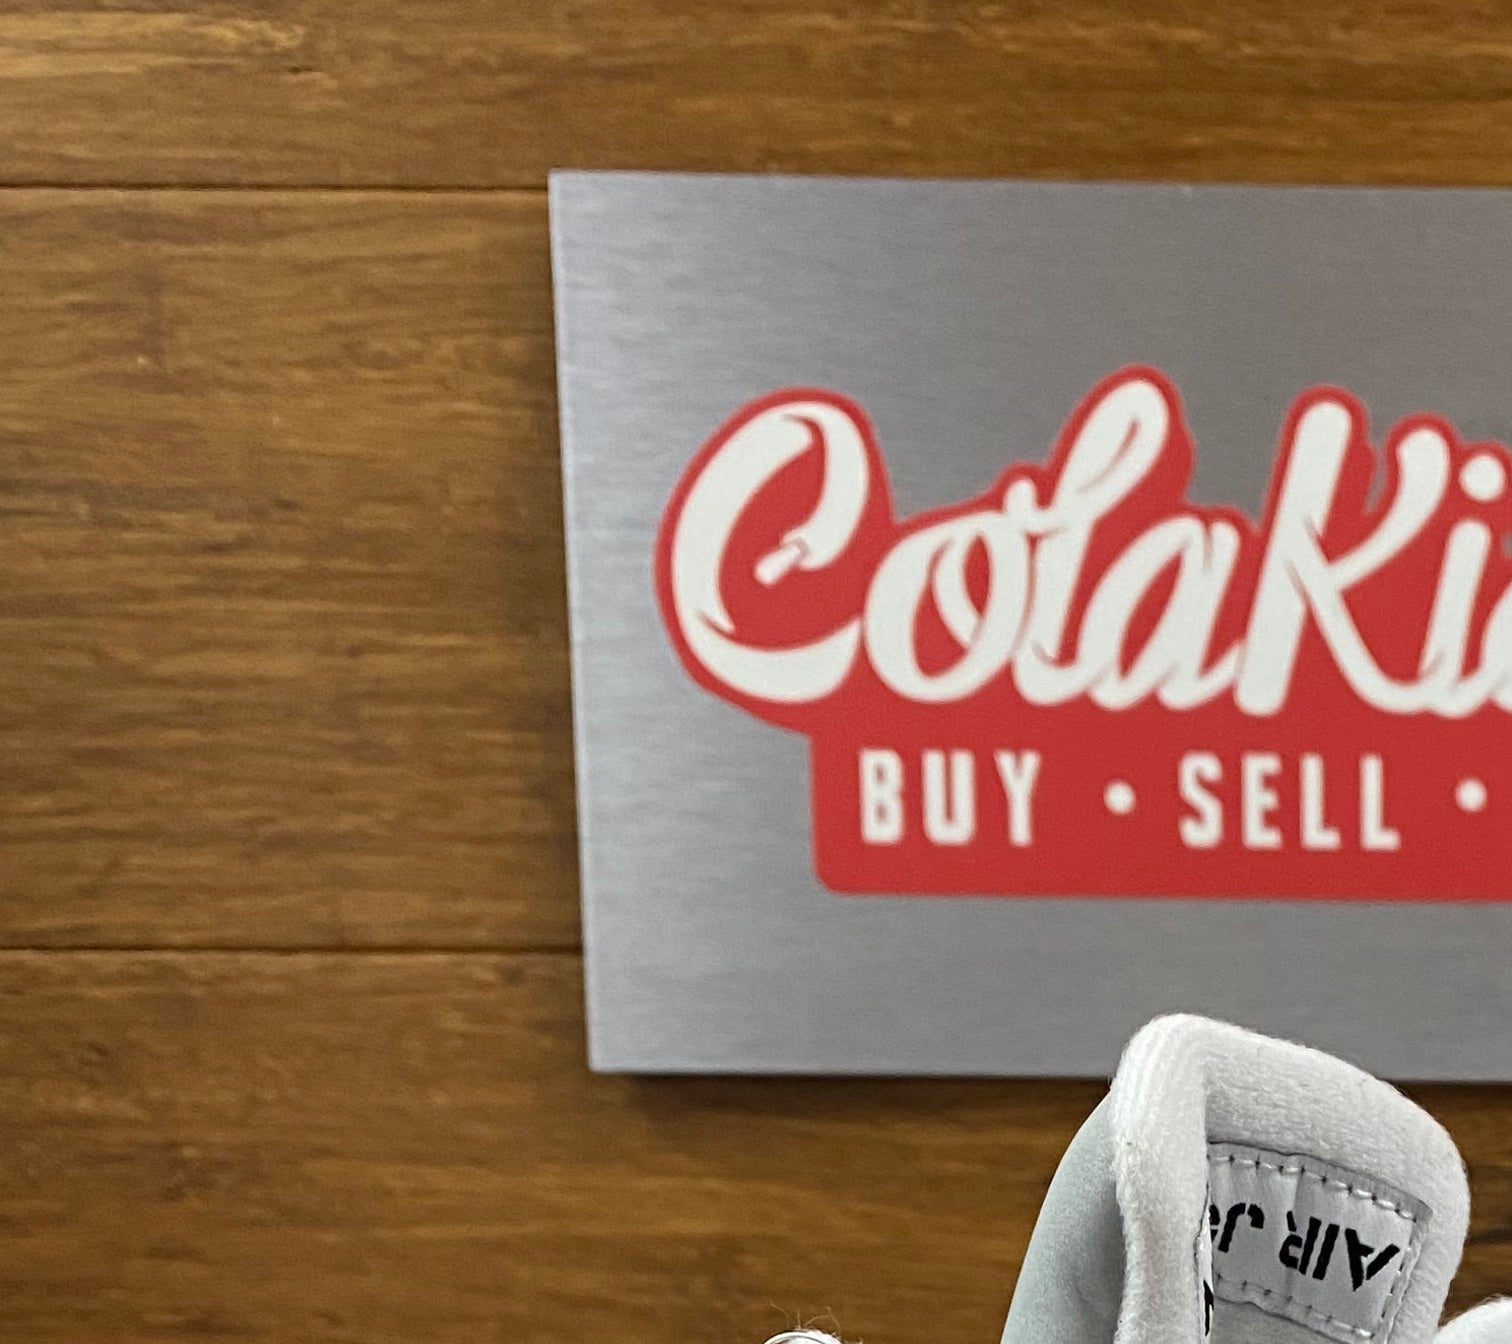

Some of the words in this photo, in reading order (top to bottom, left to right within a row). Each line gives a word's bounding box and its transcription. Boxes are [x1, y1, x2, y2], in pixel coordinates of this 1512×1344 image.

[858, 747, 1041, 847] BUY
[1178, 752, 1402, 852] SELL
[1278, 1210, 1400, 1292] AIR
